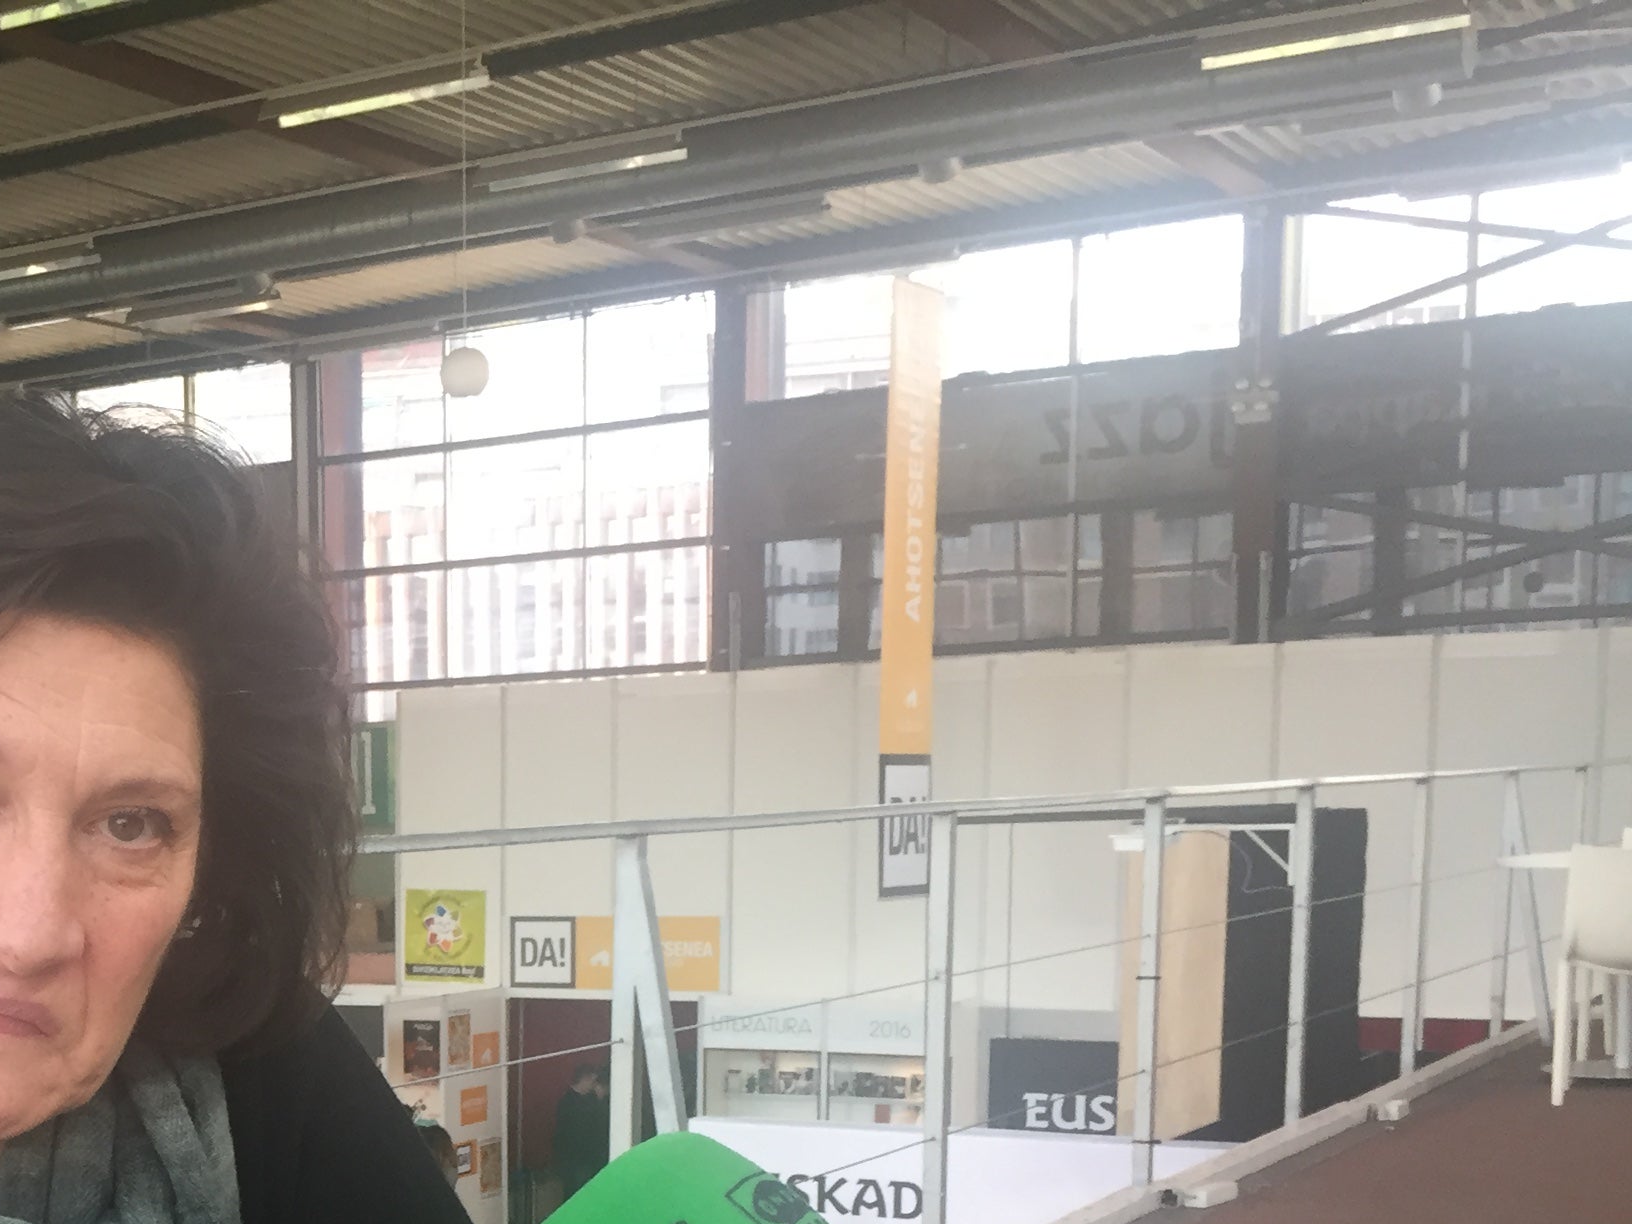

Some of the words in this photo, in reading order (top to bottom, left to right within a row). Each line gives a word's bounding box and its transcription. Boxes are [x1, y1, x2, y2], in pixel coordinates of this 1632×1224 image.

[519, 936, 567, 968] DA!
[661, 940, 714, 959] SENEA
[709, 1014, 813, 1035] LITERATURA
[868, 1018, 912, 1040] 2016
[1022, 1091, 1116, 1133] EUS
[775, 1172, 924, 1221] SKAD
